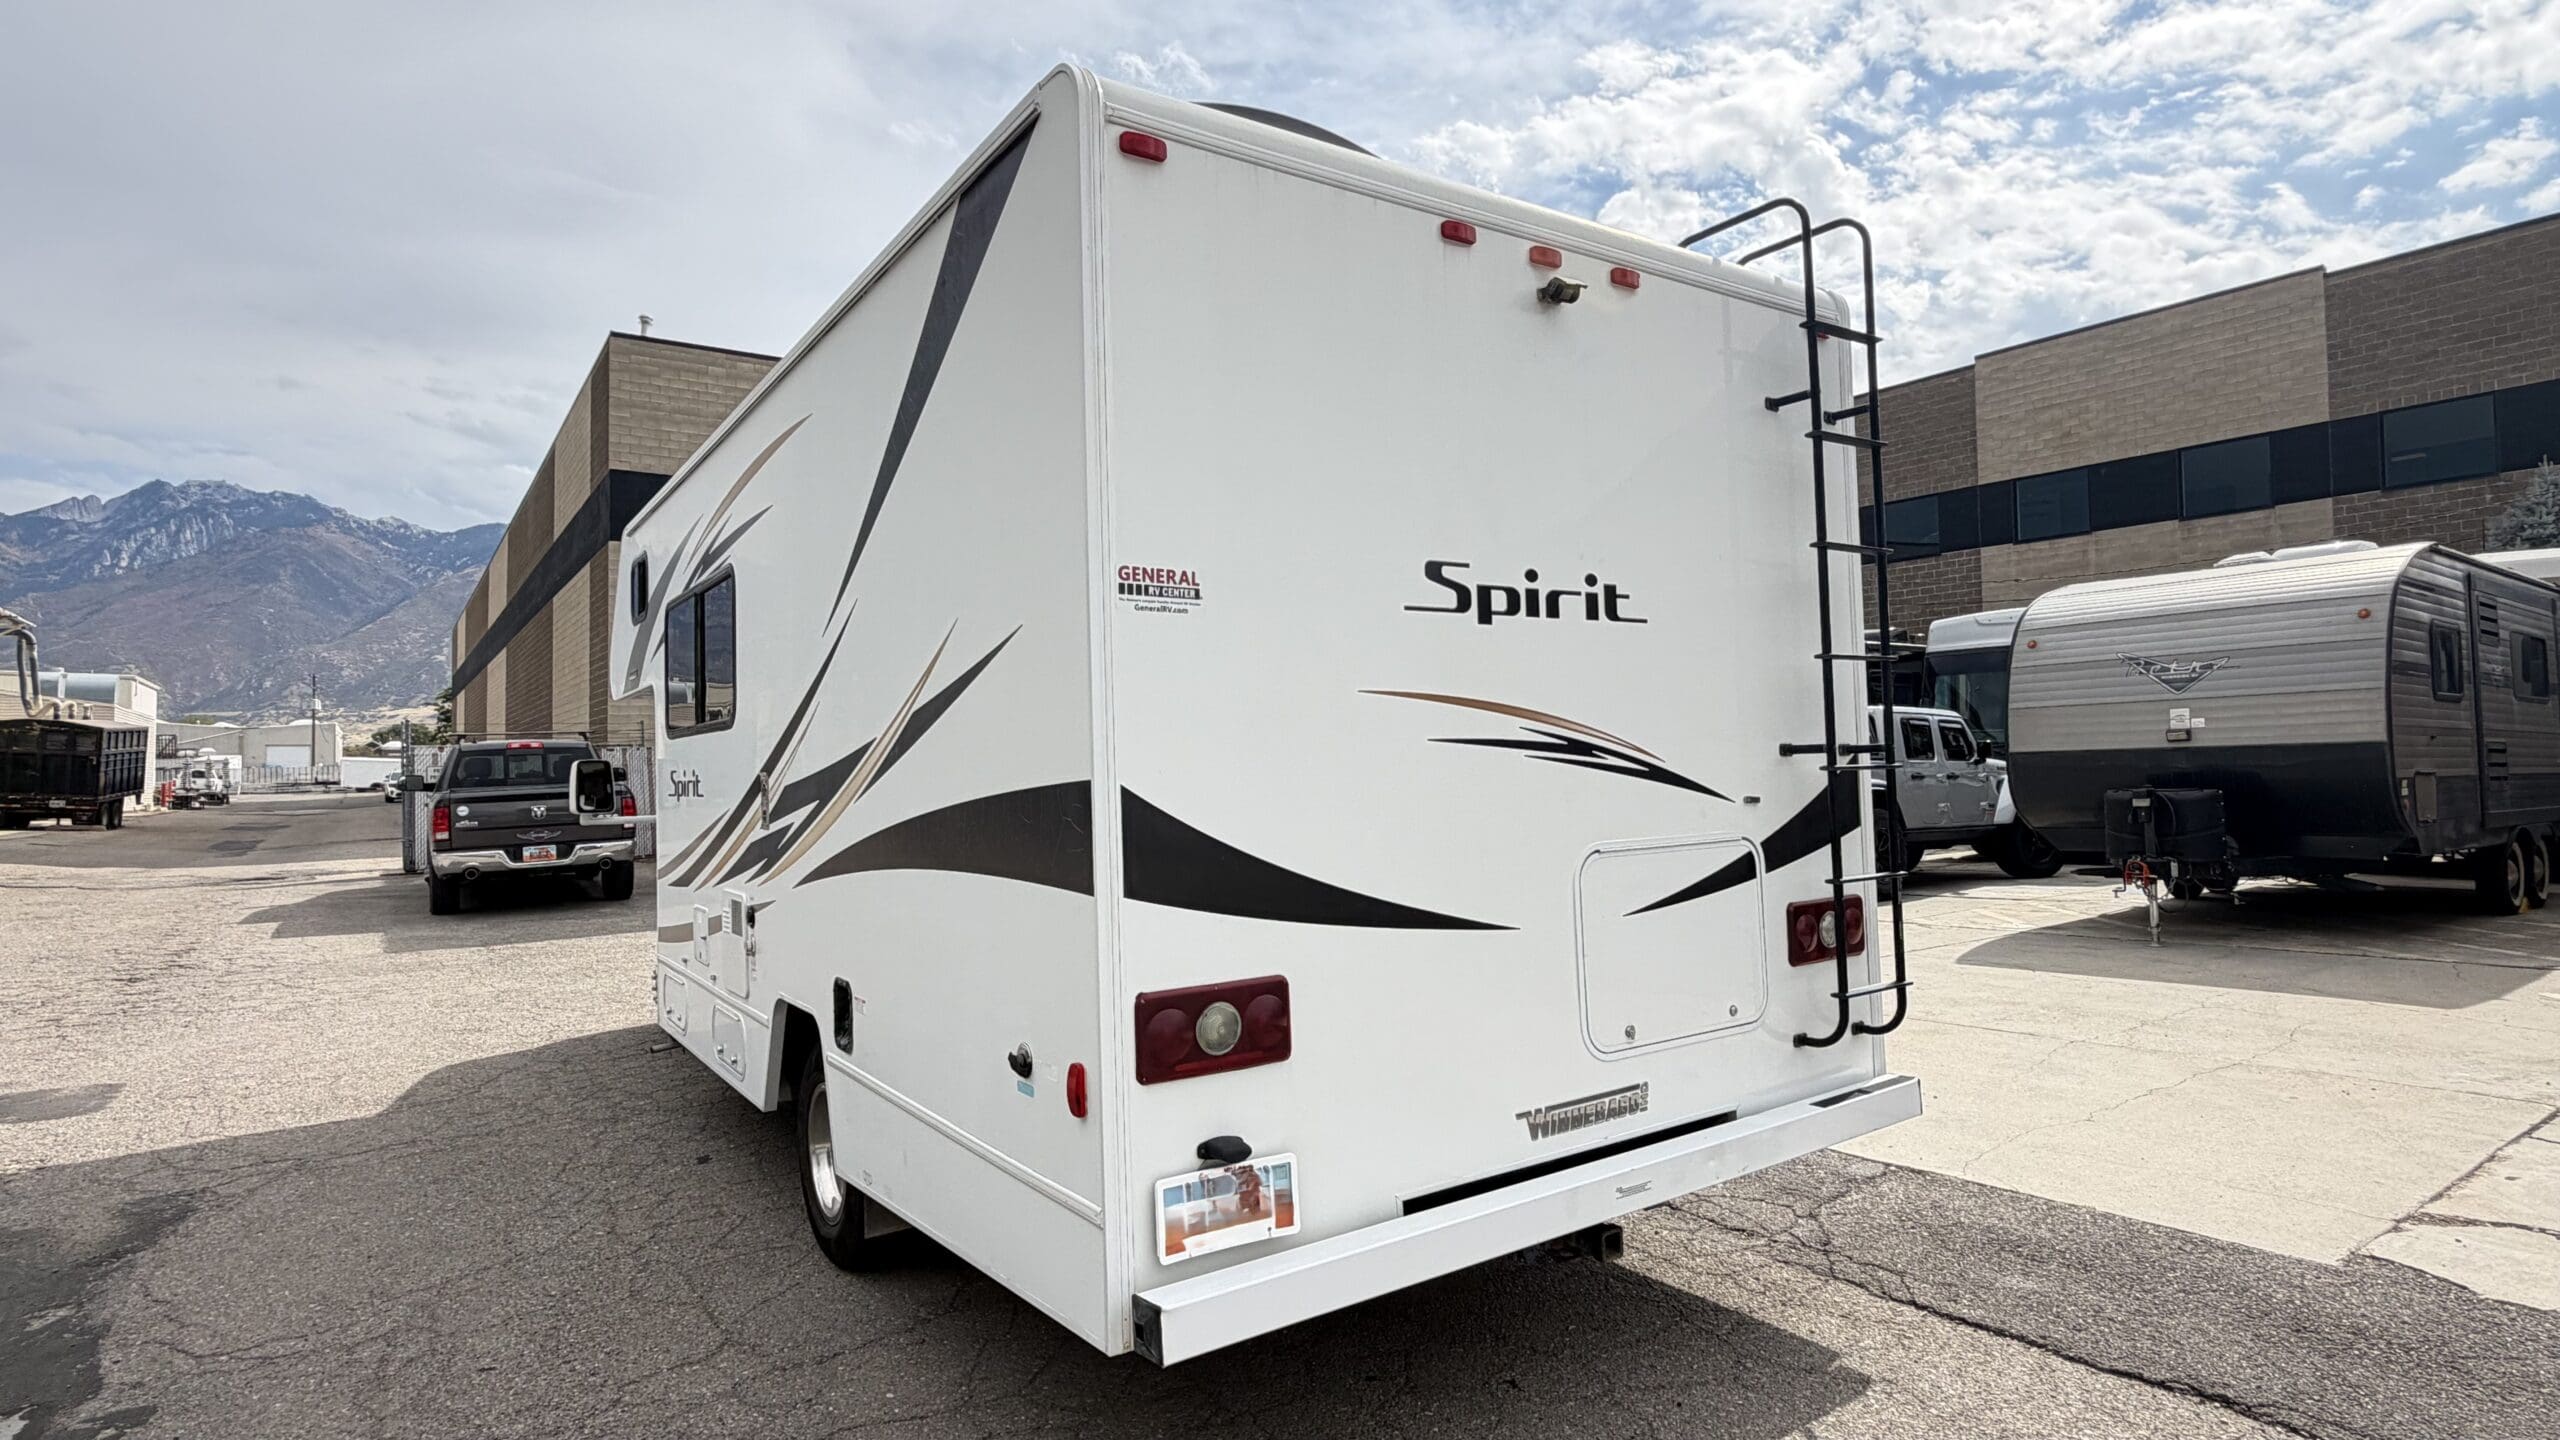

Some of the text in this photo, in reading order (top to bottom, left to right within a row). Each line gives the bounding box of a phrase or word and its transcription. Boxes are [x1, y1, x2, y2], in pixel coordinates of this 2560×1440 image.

[1118, 565, 1200, 587] GENERAL
[1148, 586, 1196, 599] RV CENTER
[1404, 559, 1648, 625] Spirit
[1134, 603, 1189, 614] GeneralRV.com
[668, 769, 704, 802] Spirit
[1515, 1083, 1640, 1142] WINNEBAGO
